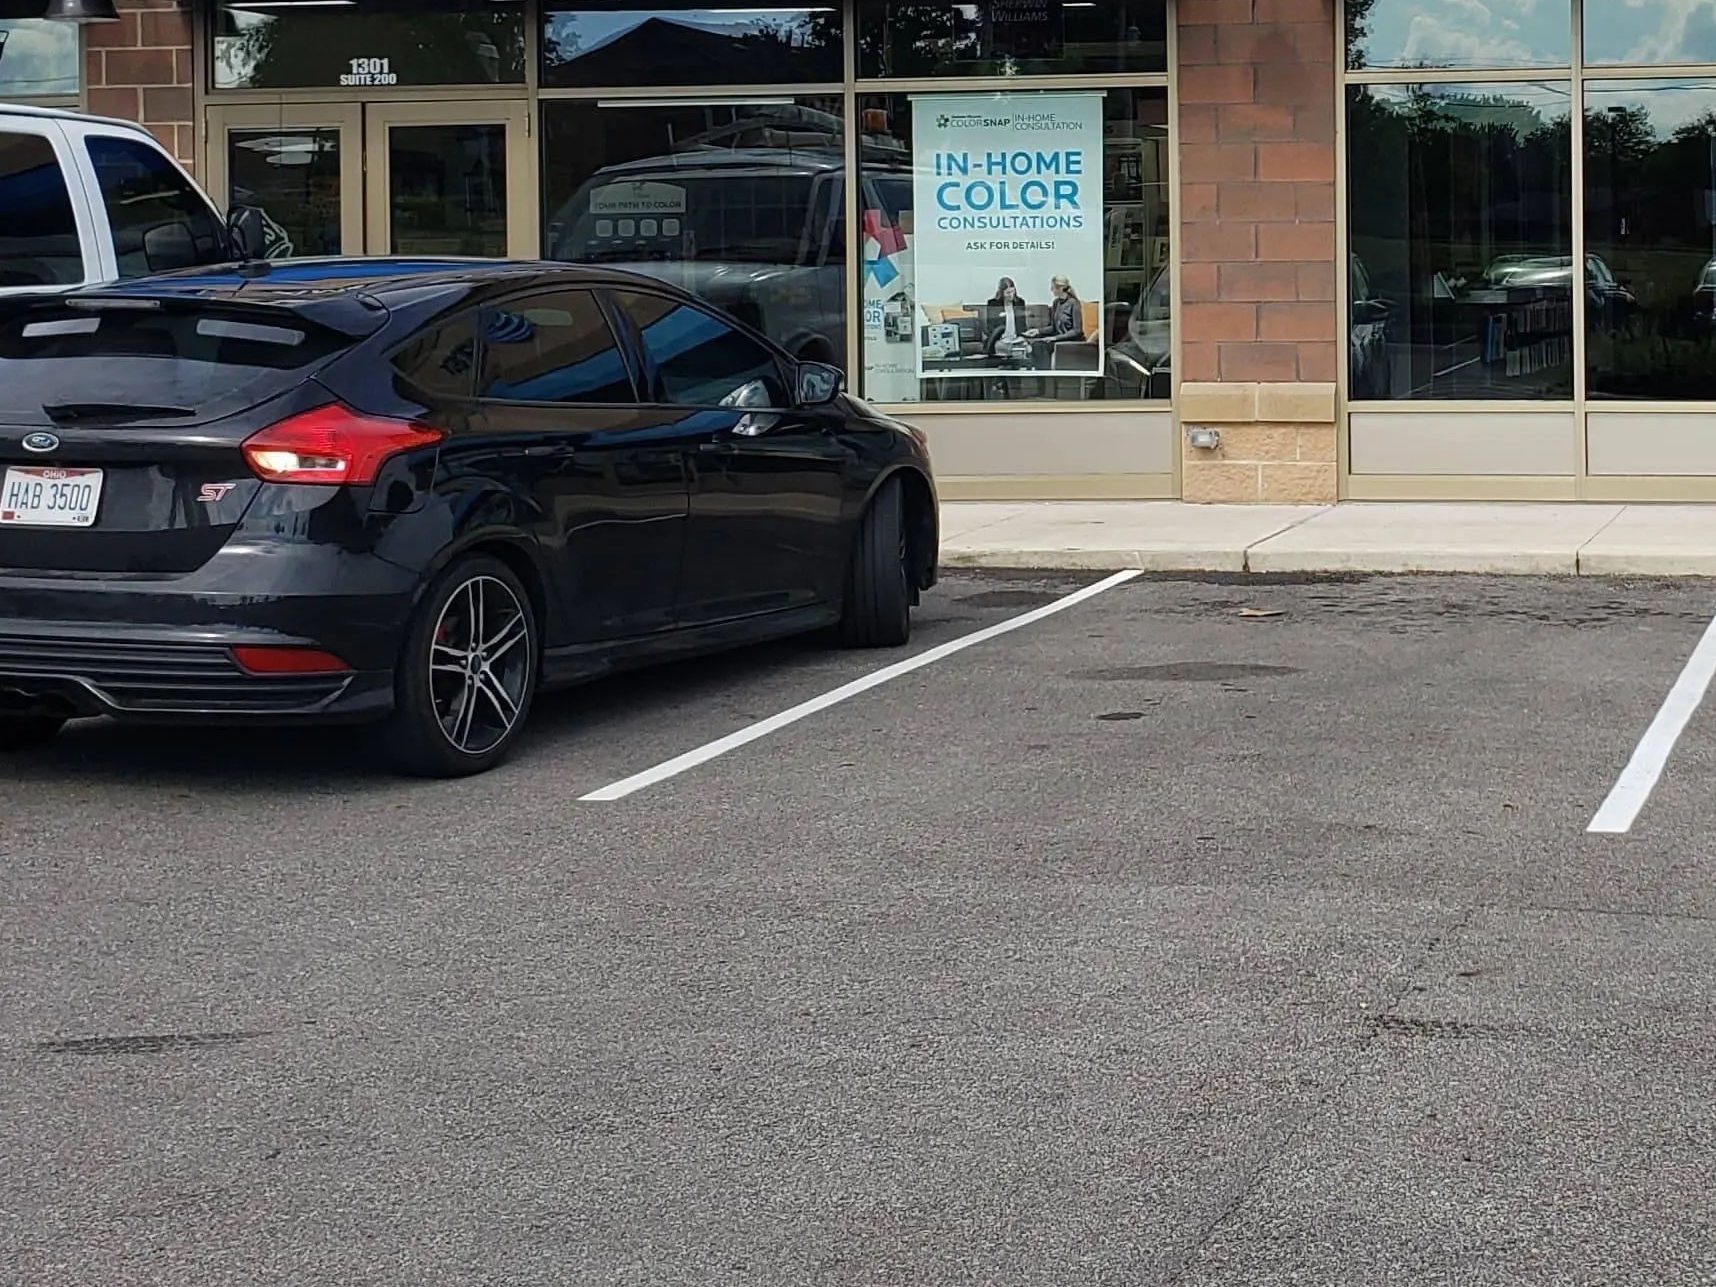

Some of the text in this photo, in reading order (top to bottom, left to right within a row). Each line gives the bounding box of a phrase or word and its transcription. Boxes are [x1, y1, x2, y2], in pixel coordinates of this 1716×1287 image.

[991, 10, 1048, 22] WILLIAMS
[349, 58, 389, 74] 1301
[340, 73, 397, 85] SUITE 200
[1015, 114, 1056, 122] IN-HOME
[1014, 122, 1083, 131] CONSULTATION
[935, 151, 1083, 176] IN-HOME
[936, 180, 1081, 211] COLOR
[653, 201, 681, 209] COLOR
[936, 215, 1083, 230] CONSULTATIONS
[966, 241, 1055, 250] ASK FOR DETAILS!
[42, 470, 67, 479] OHIO
[8, 482, 92, 511] HAB 3500
[196, 483, 237, 502] ST
